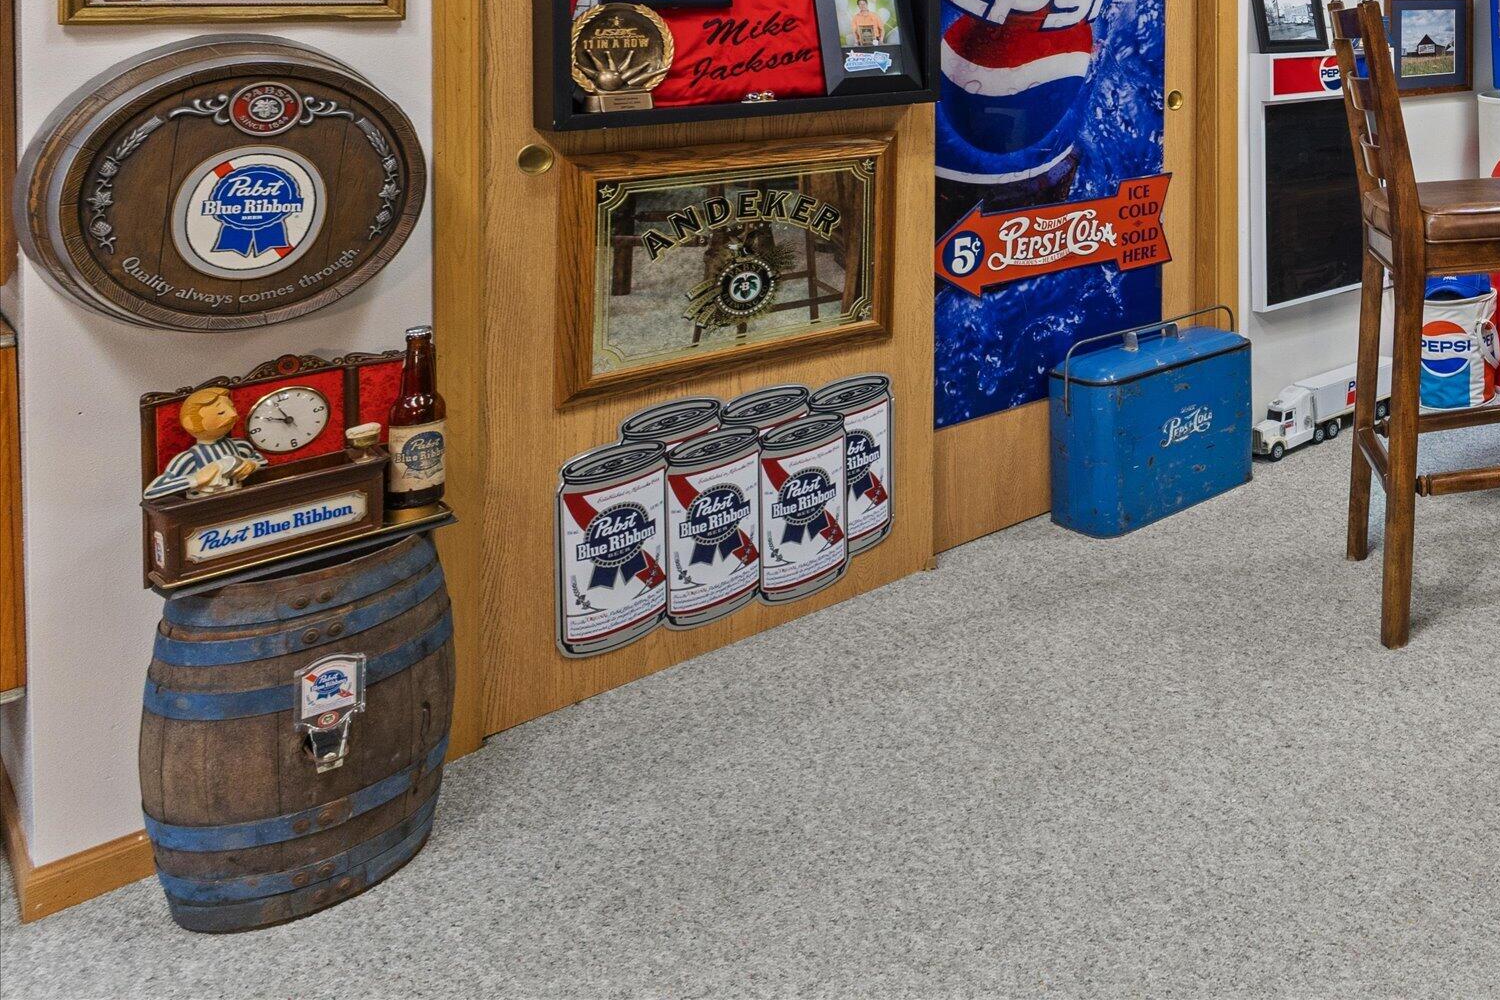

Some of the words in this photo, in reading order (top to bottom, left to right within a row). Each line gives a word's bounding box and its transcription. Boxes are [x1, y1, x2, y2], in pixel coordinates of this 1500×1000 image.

[703, 11, 799, 47] Mike
[583, 39, 594, 50] 11
[597, 38, 610, 50] IN
[613, 38, 621, 49] A
[624, 37, 649, 49] ROW
[690, 47, 814, 89] Jackson
[1321, 68, 1340, 78] PEP
[242, 86, 295, 104] PABST
[240, 115, 266, 131] SINCE
[227, 176, 285, 197] Pabst
[1128, 184, 1150, 201] ICE
[203, 200, 241, 215] Blue
[244, 199, 301, 214] Ribbon
[1118, 201, 1159, 220] COLD
[641, 189, 841, 263] ANDEKER
[1121, 226, 1158, 247] SOLD
[1122, 244, 1157, 264] HERE
[121, 256, 175, 296] Quality
[175, 285, 234, 309] always
[238, 284, 295, 304] comes
[298, 246, 361, 289] through.
[410, 438, 441, 451] Pabst
[847, 437, 867, 456] bst
[396, 453, 418, 463] Blue
[420, 448, 444, 461] Ribb
[786, 476, 822, 500] Pabst
[695, 492, 734, 518] Pabst
[772, 501, 798, 518] Blue
[798, 487, 836, 511] Ribbon
[199, 525, 250, 552] Pabst
[252, 519, 290, 539] Blue
[292, 503, 354, 528] Ribbon
[594, 511, 638, 540] Pabst
[680, 520, 708, 538] Blue
[708, 506, 750, 530] Ribbon
[577, 542, 607, 561] Blue
[608, 524, 656, 552] Ribbon
